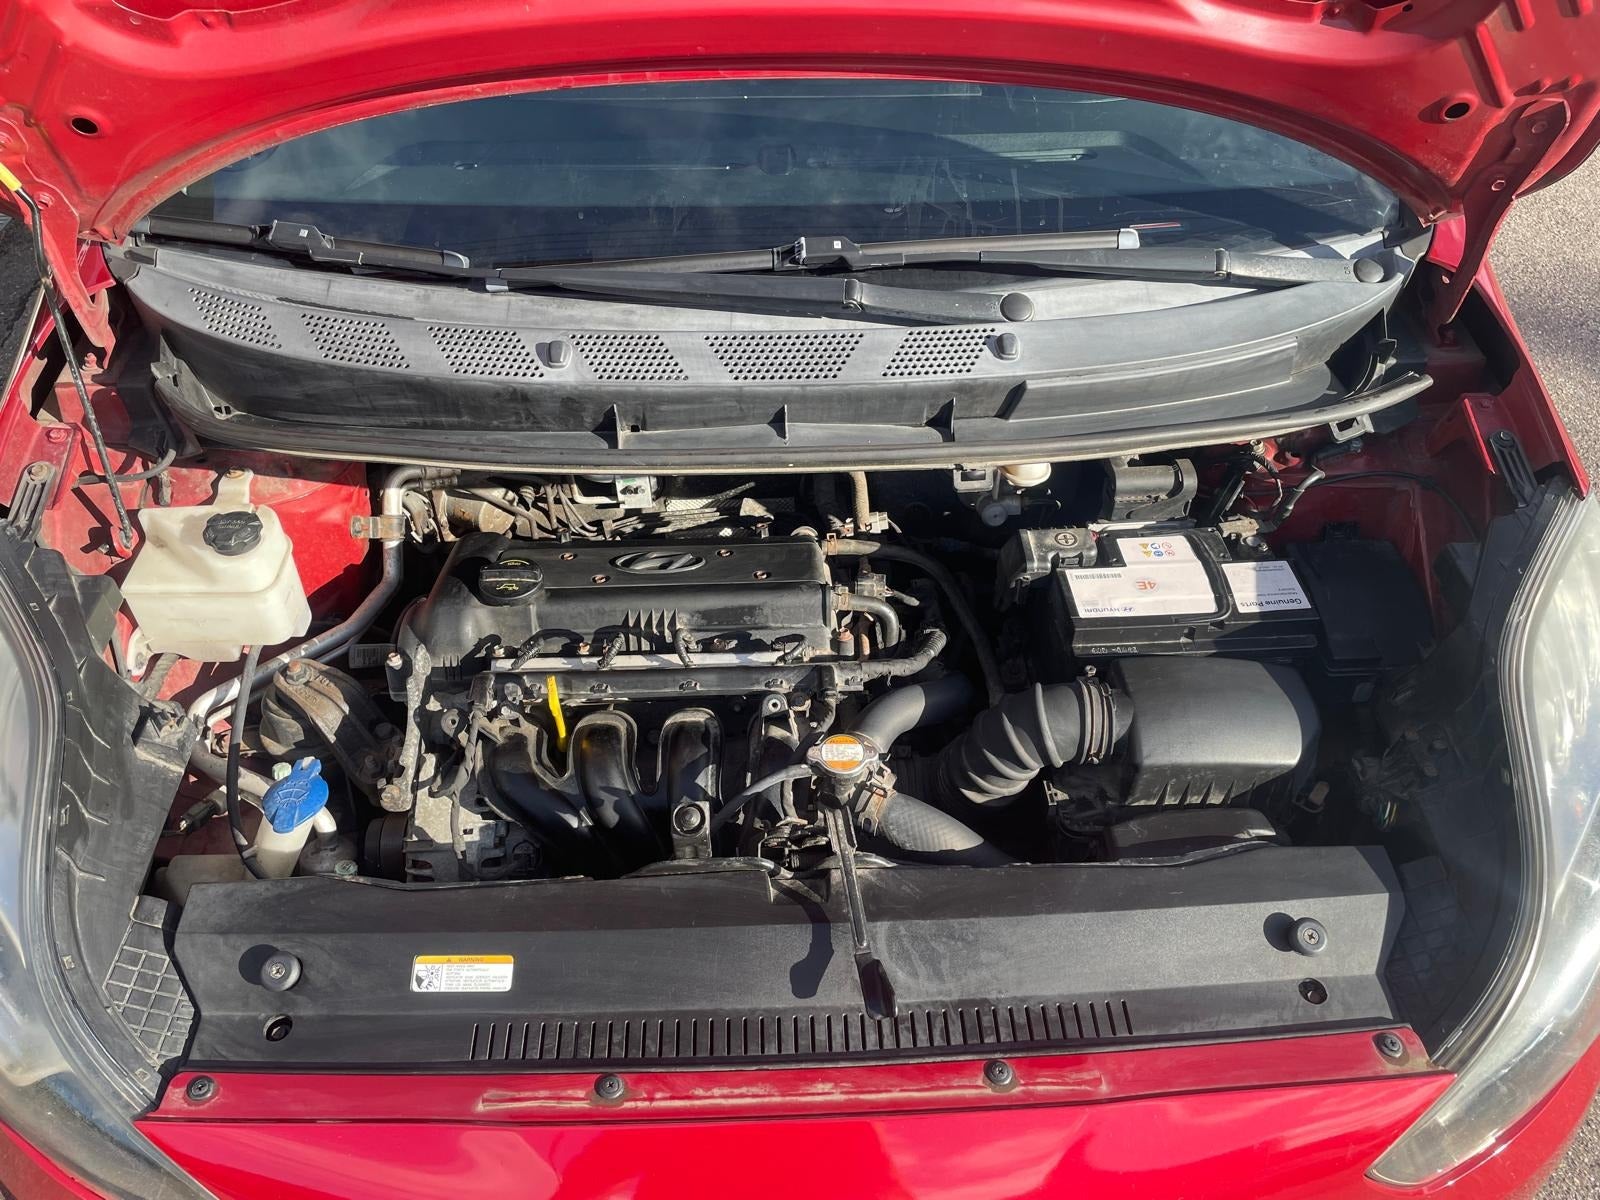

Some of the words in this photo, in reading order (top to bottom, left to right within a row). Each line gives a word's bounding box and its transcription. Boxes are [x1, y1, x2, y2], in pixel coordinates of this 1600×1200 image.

[1135, 580, 1158, 591] 4E
[1239, 600, 1264, 609] Parts
[1265, 597, 1302, 607] Genuine
